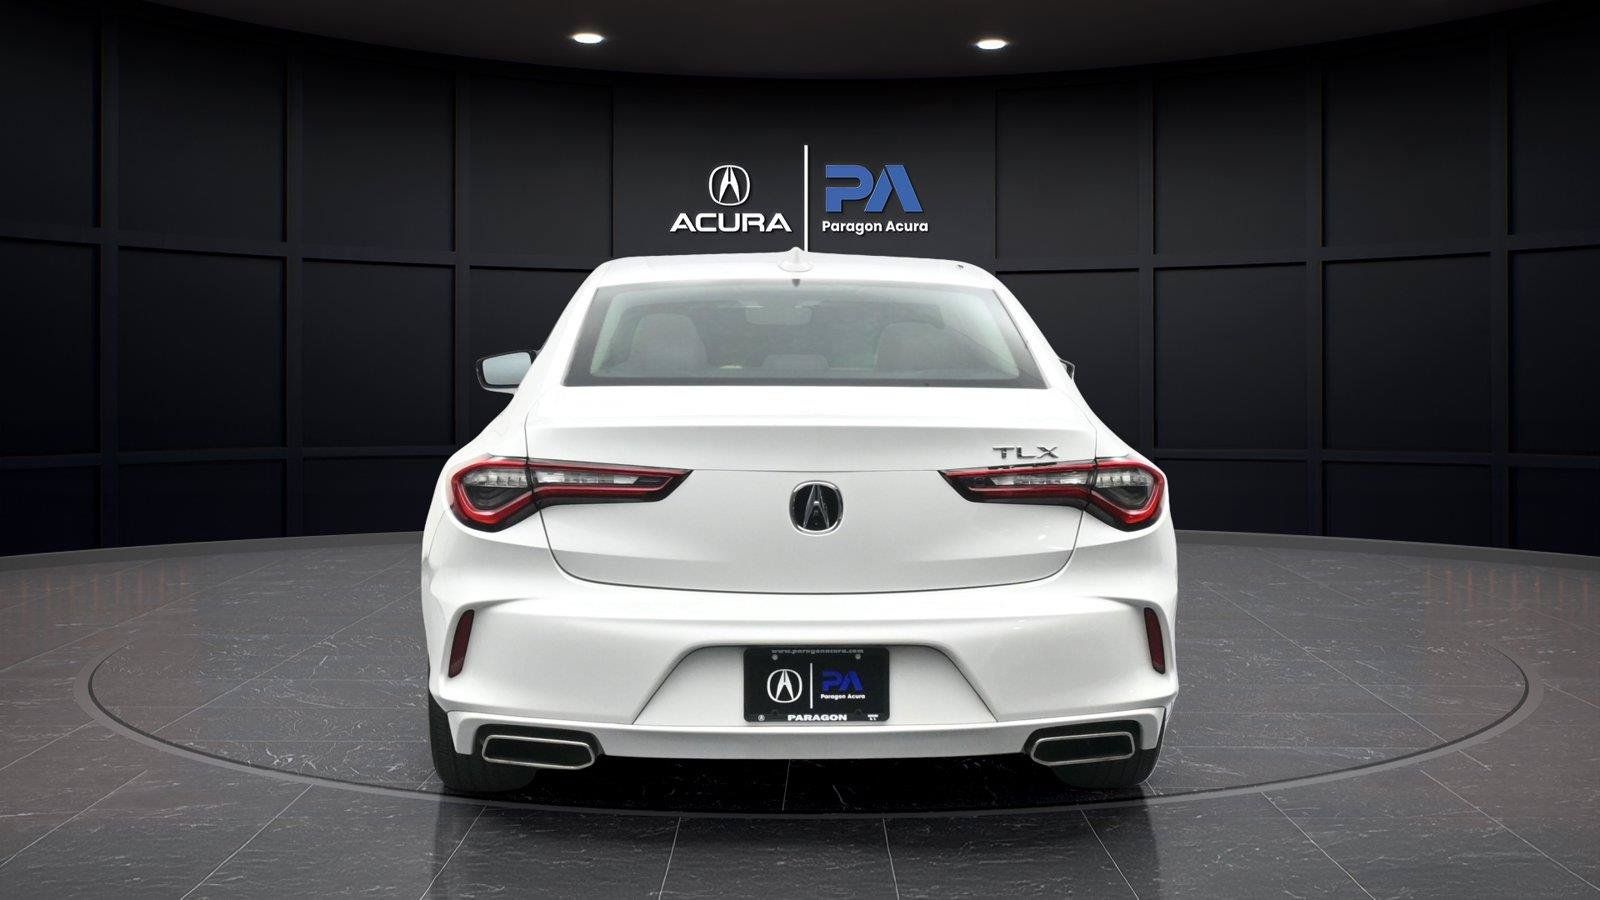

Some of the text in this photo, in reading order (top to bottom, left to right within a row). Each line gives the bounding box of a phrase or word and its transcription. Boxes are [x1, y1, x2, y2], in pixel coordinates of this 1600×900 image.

[669, 212, 792, 232] ACURA
[822, 220, 929, 236] Paragon Acura
[992, 446, 1059, 460] TLX
[820, 693, 846, 701] Paragon
